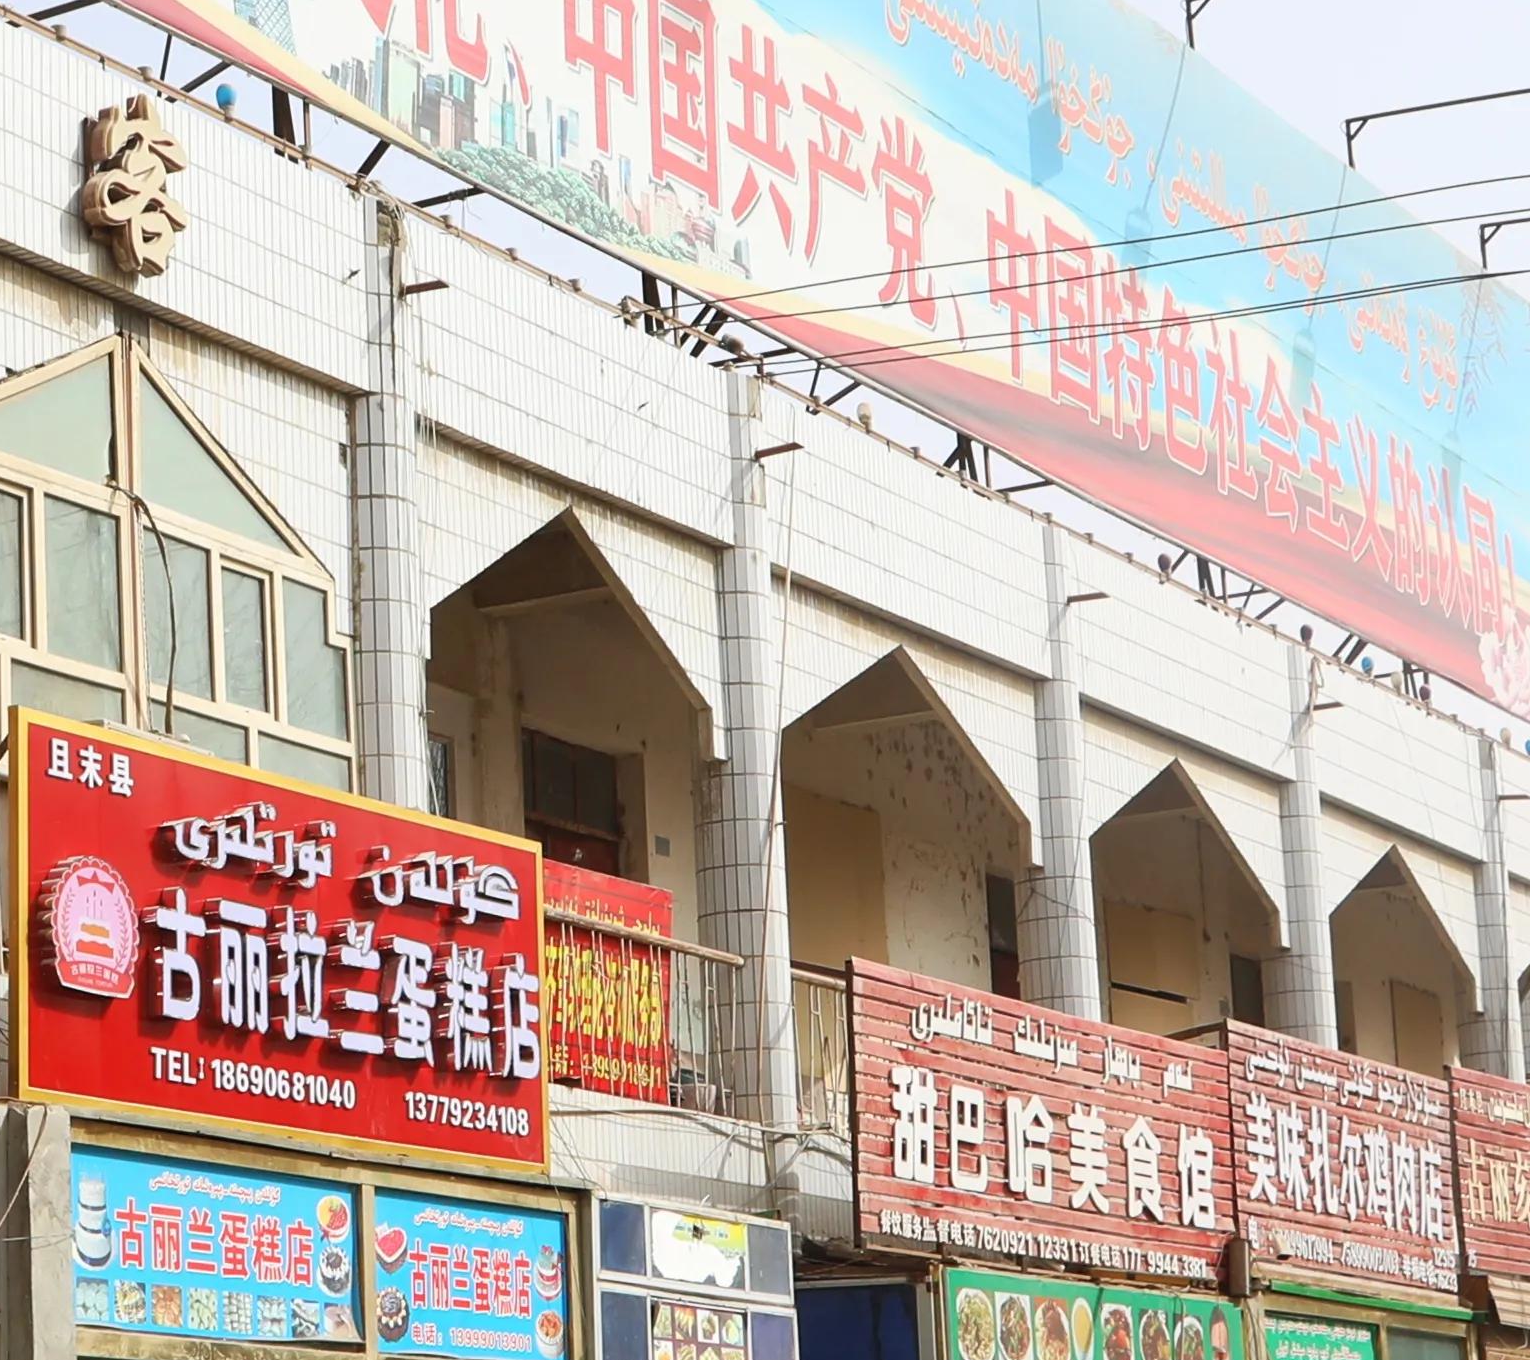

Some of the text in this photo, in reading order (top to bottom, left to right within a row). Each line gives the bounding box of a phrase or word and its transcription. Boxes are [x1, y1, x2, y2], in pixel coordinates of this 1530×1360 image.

[48, 738, 135, 798] 且末县
[150, 886, 541, 1080] 古丽拉兰蛋糕店
[211, 1058, 357, 1109] 18690681040
[404, 1091, 530, 1137] 13779234108
[892, 1066, 1217, 1231] 甜巴哈美食馆
[1245, 1091, 1443, 1242] 美味扎尔鸡肉店
[114, 1197, 315, 1288] 古丽兰蛋糕店
[408, 1238, 531, 1319] 古丽兰蛋糕店
